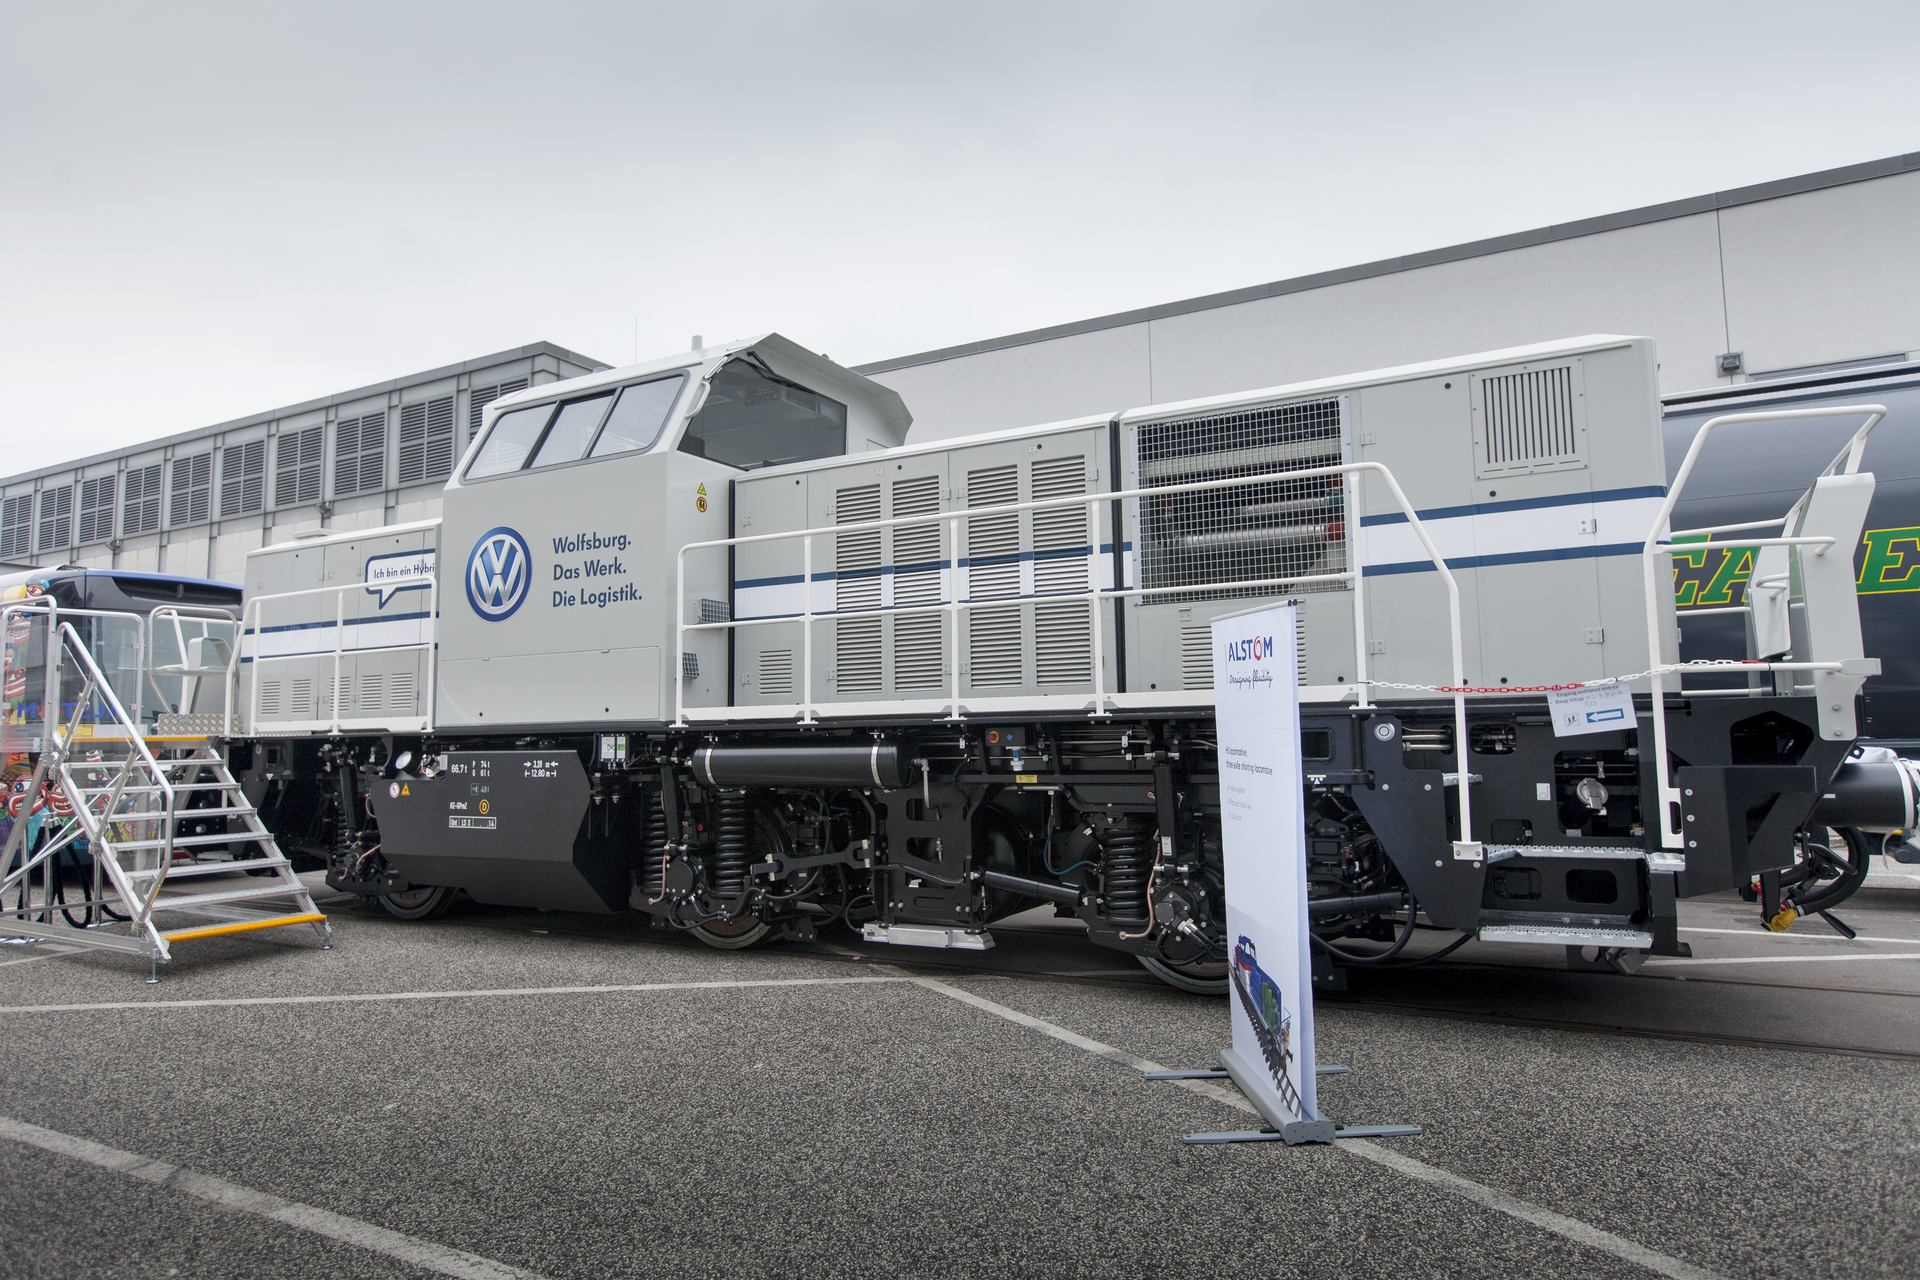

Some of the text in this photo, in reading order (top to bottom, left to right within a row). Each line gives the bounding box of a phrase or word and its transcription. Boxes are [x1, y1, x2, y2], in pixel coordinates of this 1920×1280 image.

[552, 532, 632, 554] Wolfsburg.
[374, 568, 384, 578] Ich
[386, 567, 398, 577] bin
[400, 566, 411, 576] ein
[553, 556, 626, 580] Das Werk.
[552, 582, 642, 608] Die Logistik.
[1228, 636, 1272, 662] ALSTOM
